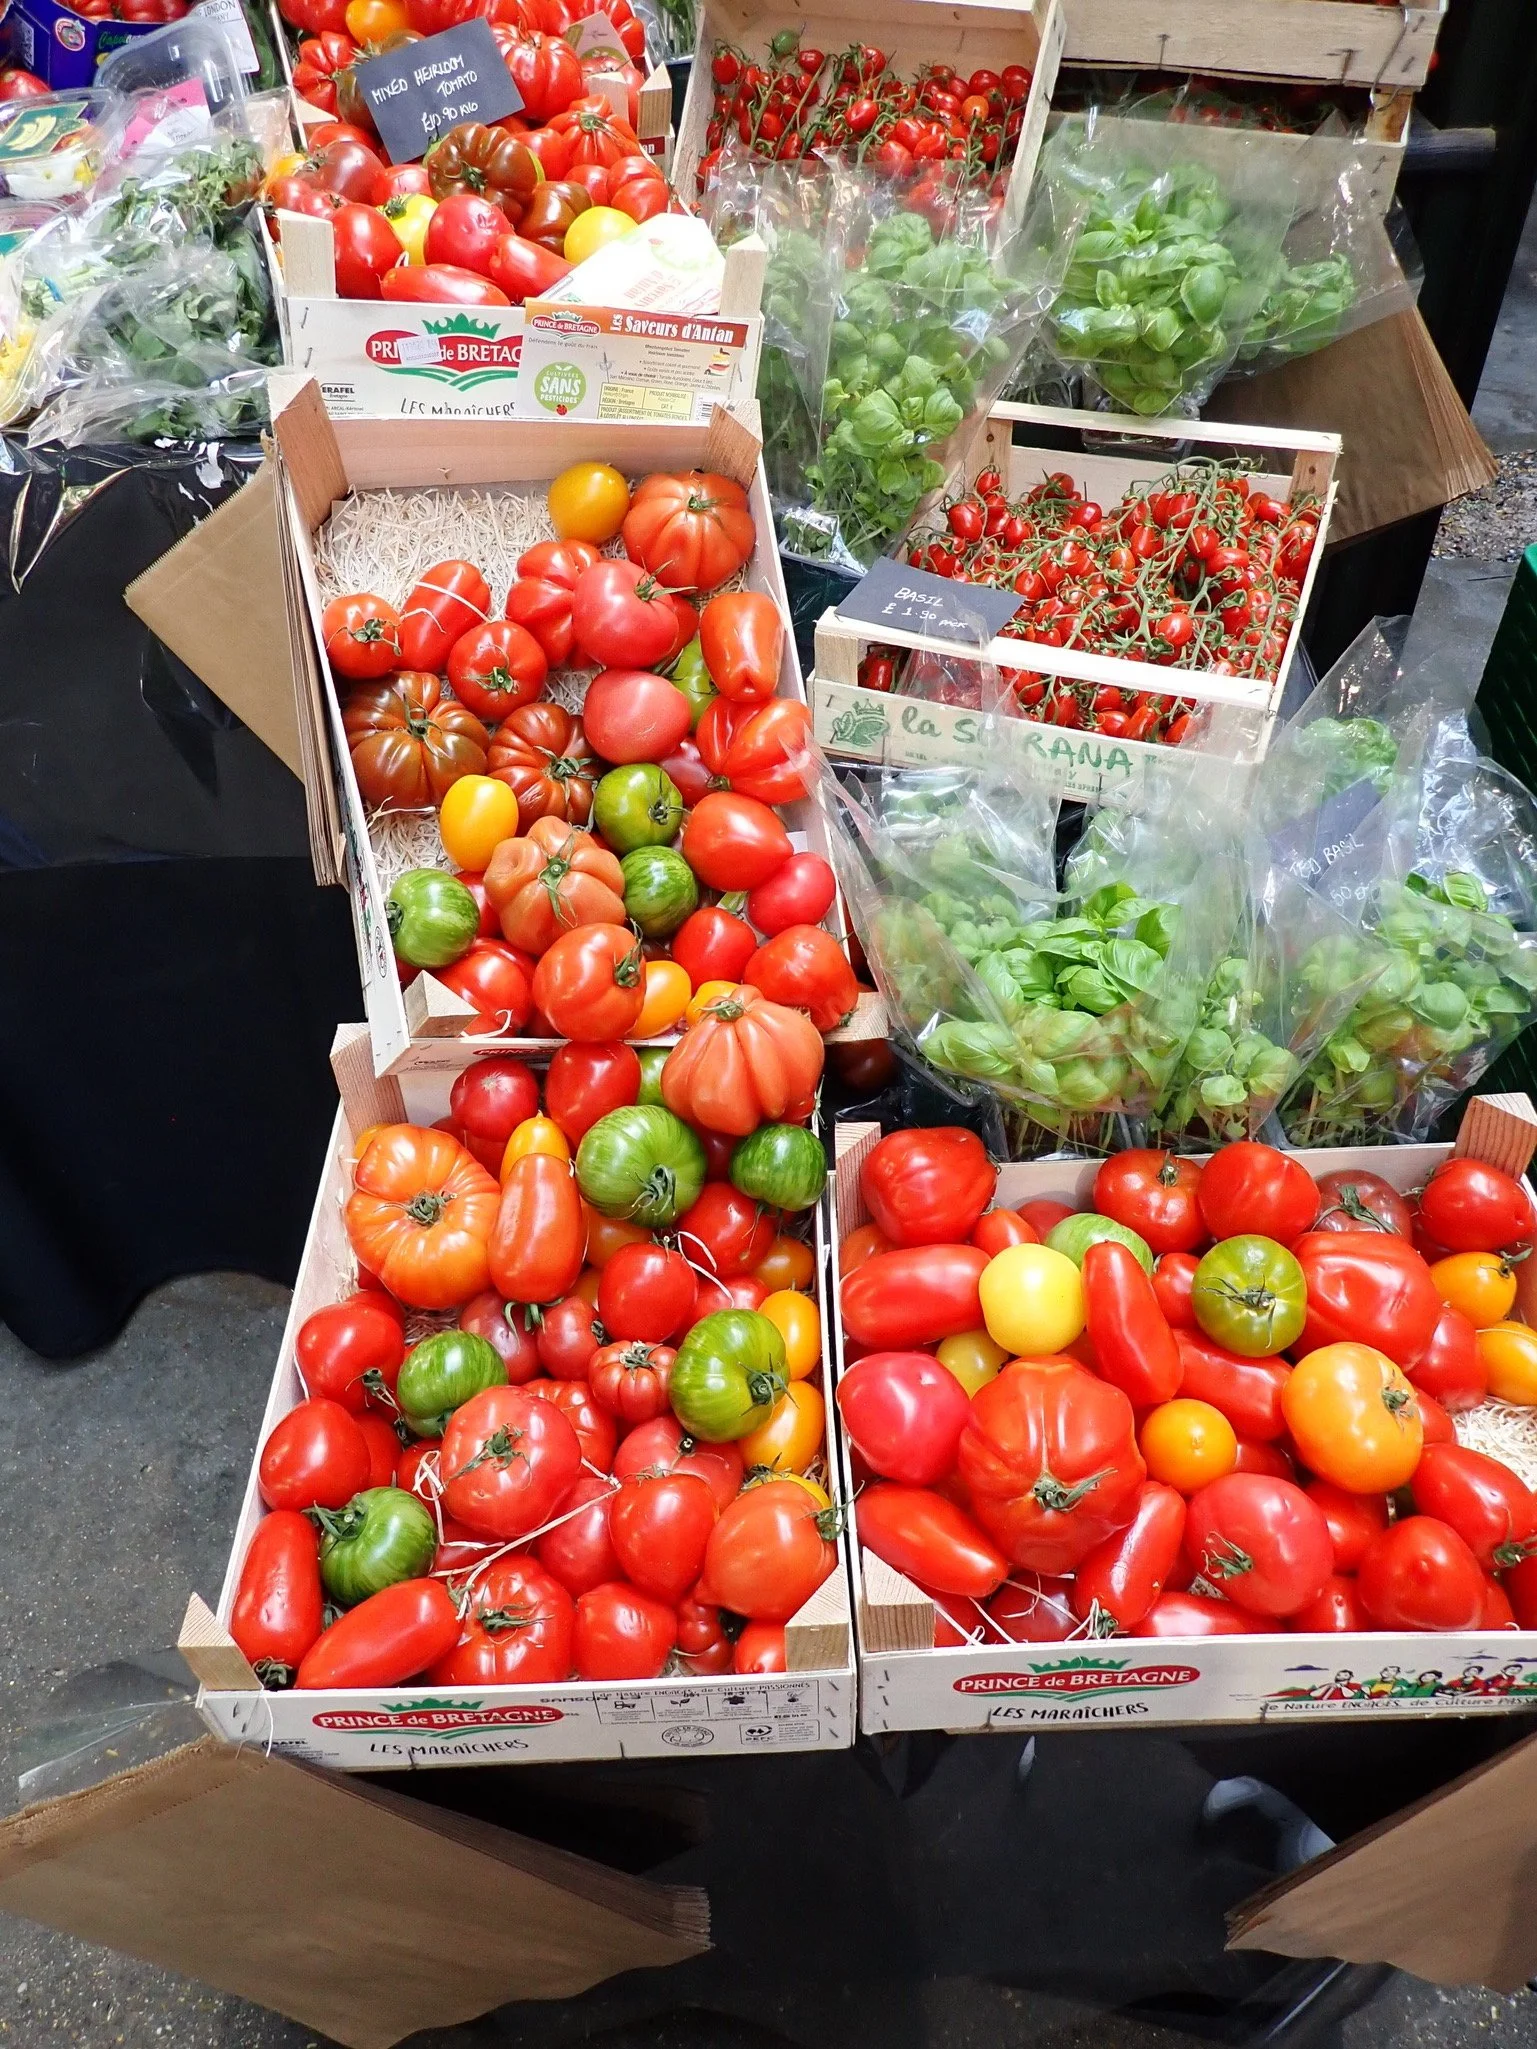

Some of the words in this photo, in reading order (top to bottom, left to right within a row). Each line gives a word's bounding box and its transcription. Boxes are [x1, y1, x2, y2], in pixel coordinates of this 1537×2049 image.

[371, 78, 409, 106] MIXED
[413, 54, 466, 87] HEIRLOOM
[436, 70, 479, 99] TOMATO
[564, 323, 598, 334] BRETAGNE
[624, 314, 679, 338] Saveurs
[681, 323, 734, 344] d'Antan
[441, 345, 455, 361] de
[540, 376, 581, 396] SANS
[540, 394, 580, 404] PESTICIDES
[894, 587, 944, 607] BASIL
[882, 603, 896, 615] £
[901, 705, 942, 738] la
[1322, 833, 1365, 866] BASIL
[960, 1676, 1041, 1691] PRINCE
[1044, 1676, 1066, 1687] de
[1069, 1670, 1191, 1686] BRETAGNE
[992, 1706, 1024, 1719] LES
[1030, 1702, 1150, 1720] MARAÎCHERS
[1284, 1701, 1337, 1711] Nature
[1410, 1699, 1431, 1707] de
[1435, 1697, 1494, 1706] Culture
[319, 1714, 404, 1727] PRINCE
[407, 1714, 429, 1725] de
[431, 1704, 556, 1725] BRETAGNE
[370, 1743, 403, 1755] LES
[409, 1738, 530, 1756] MARAÎCHERS
